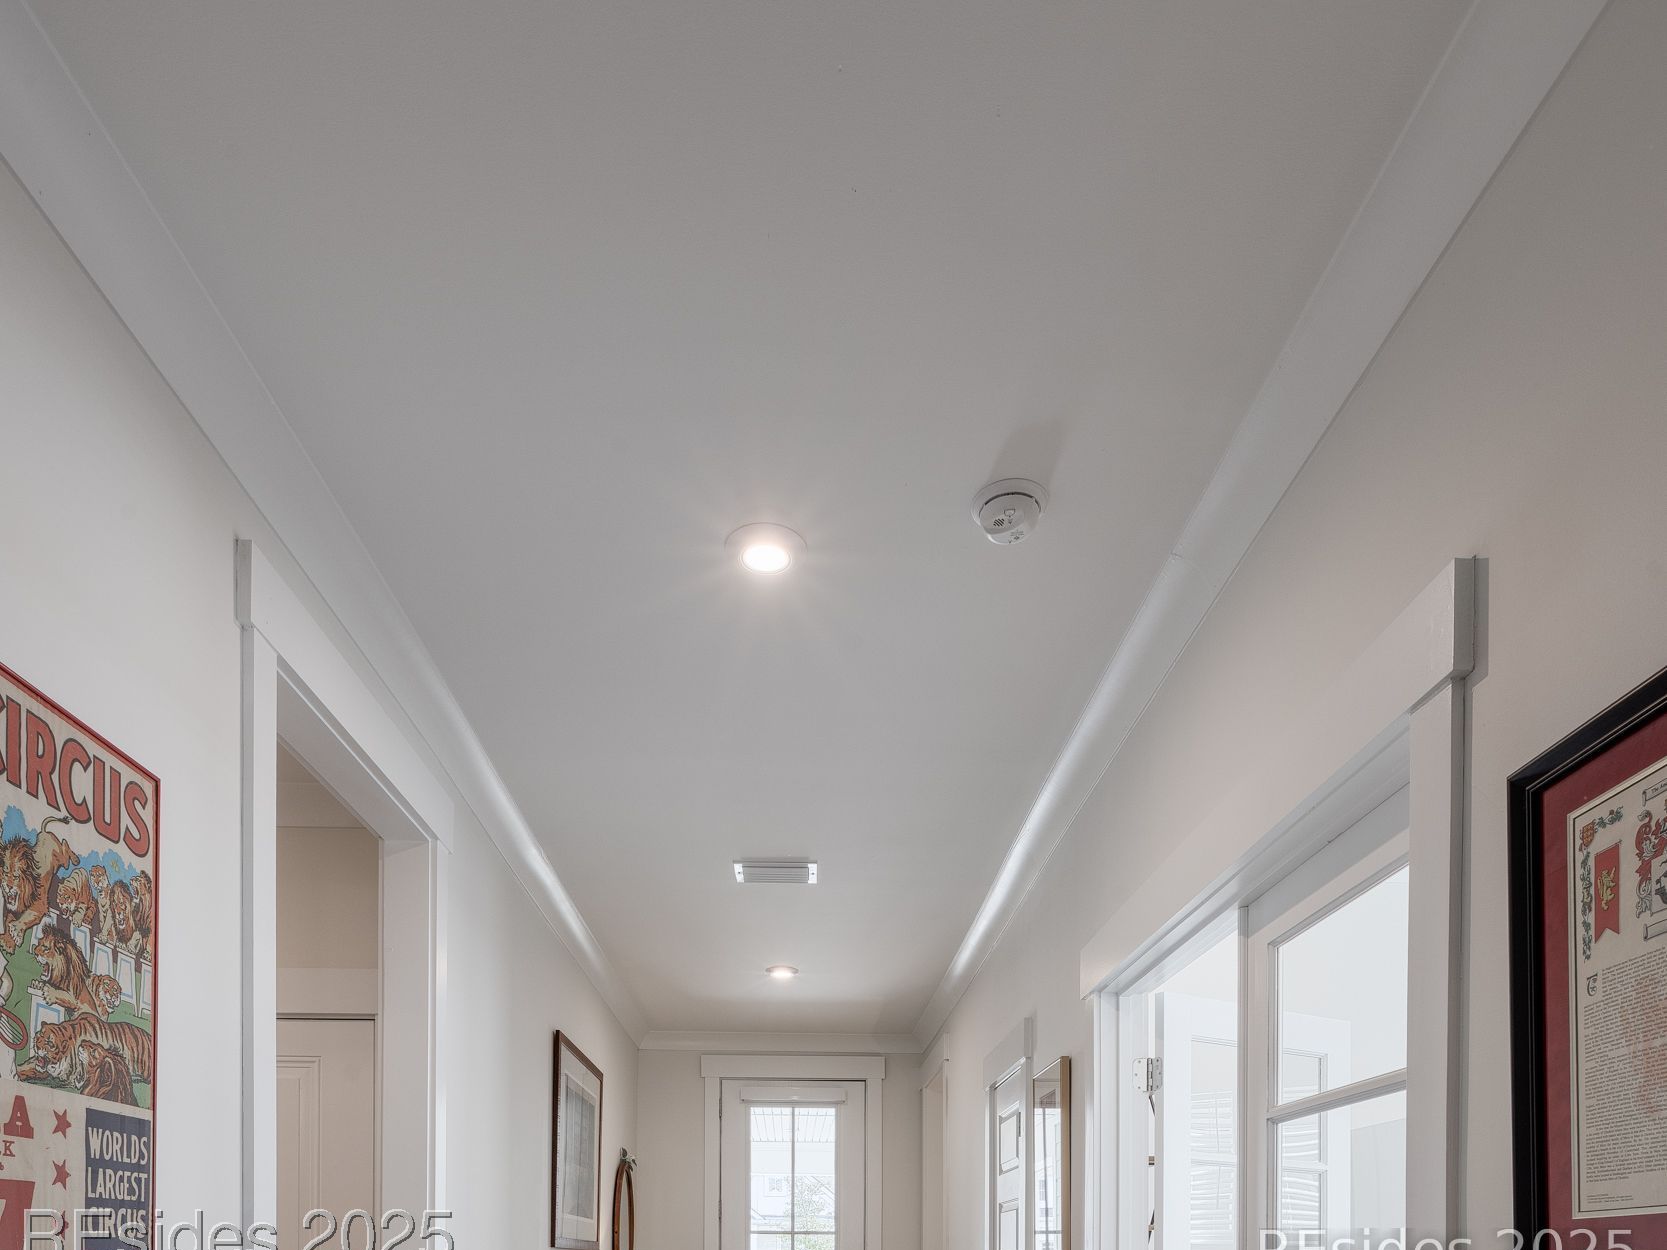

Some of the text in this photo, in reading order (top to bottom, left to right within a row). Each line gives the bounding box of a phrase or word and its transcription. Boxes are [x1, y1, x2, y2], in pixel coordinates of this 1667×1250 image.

[0, 693, 150, 858] IRCUS
[88, 1127, 148, 1165] WORLDS
[87, 1167, 148, 1202] LARGEST
[86, 1206, 147, 1238] CIRCUS
